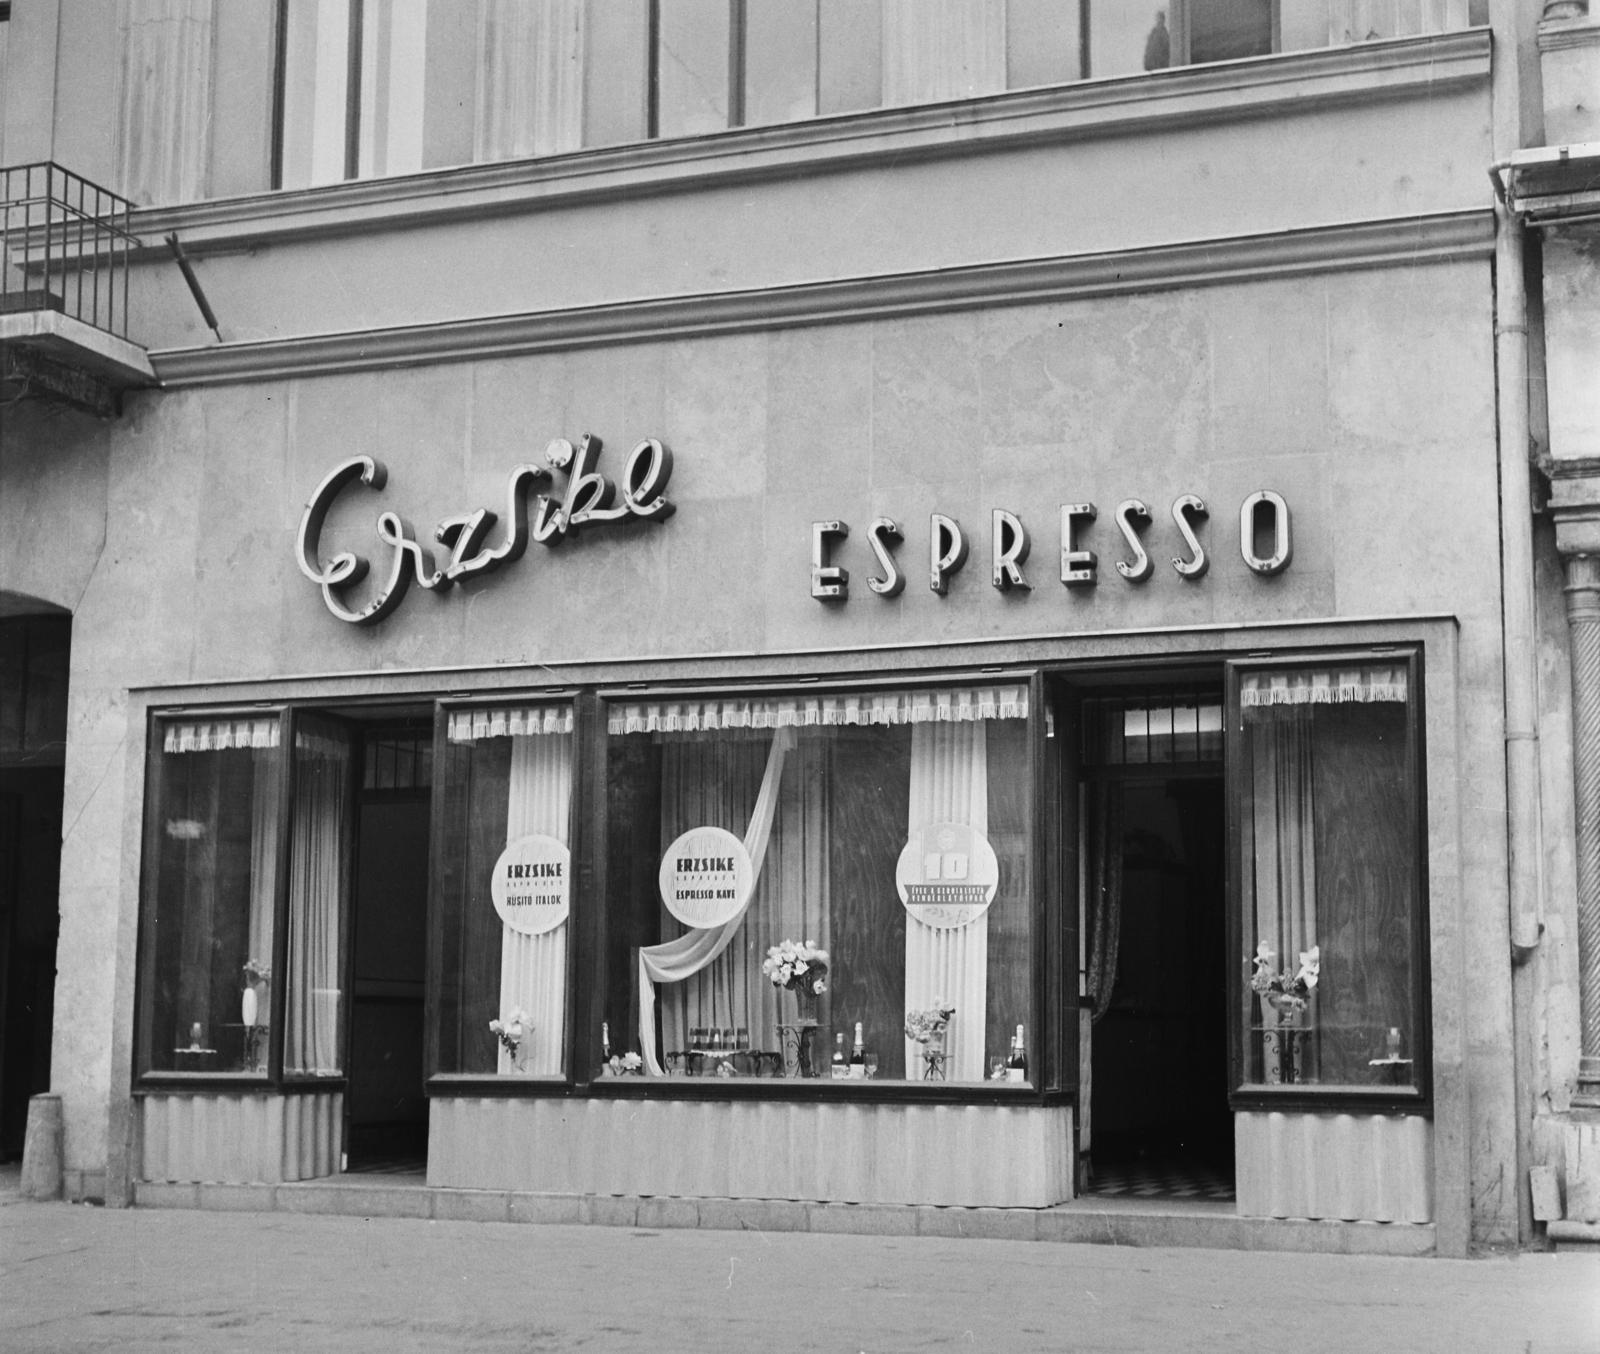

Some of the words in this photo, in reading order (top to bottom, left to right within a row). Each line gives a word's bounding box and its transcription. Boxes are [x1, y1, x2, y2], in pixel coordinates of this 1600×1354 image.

[296, 432, 676, 625] Erzsike
[811, 489, 1294, 599] ESPRESSO
[507, 862, 562, 878] ERZSIKE
[676, 857, 734, 872] ERZSIKE
[924, 852, 969, 880] 10
[535, 894, 561, 905] ITALOK
[676, 889, 714, 900] ESPRESSO
